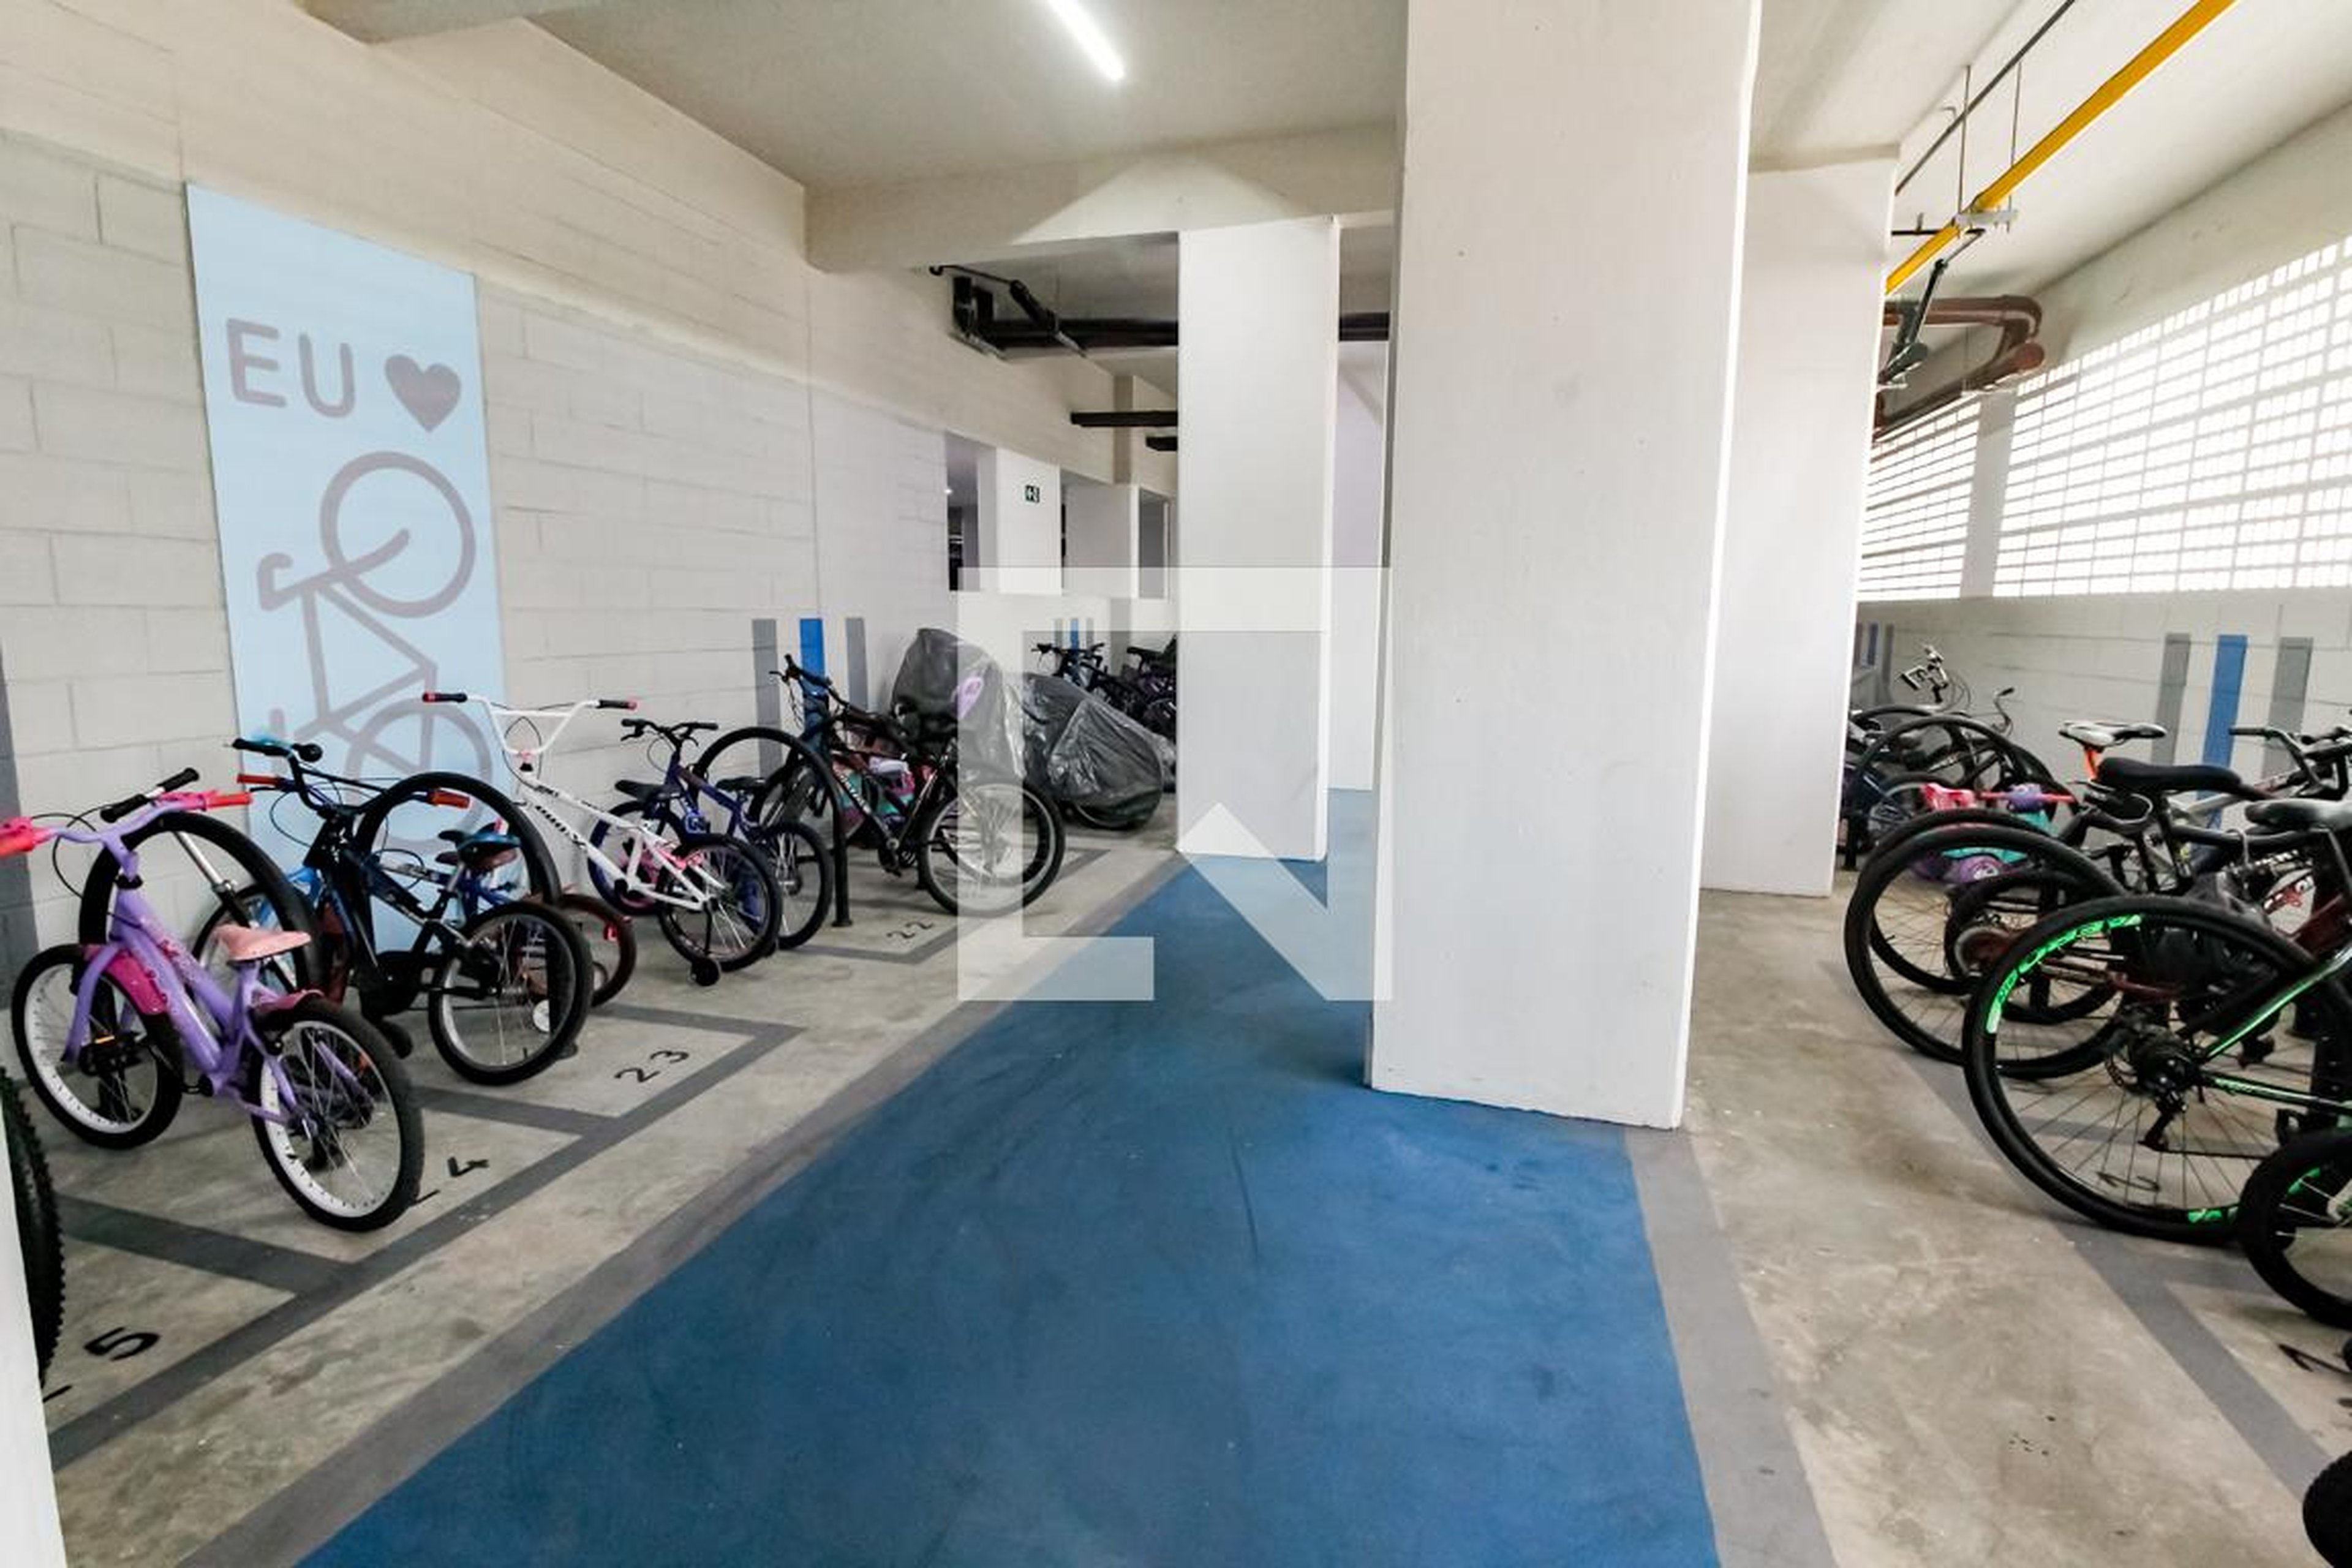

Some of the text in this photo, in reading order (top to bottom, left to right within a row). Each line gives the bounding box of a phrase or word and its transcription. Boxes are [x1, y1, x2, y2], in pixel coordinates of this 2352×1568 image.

[225, 317, 356, 418] EU
[886, 921, 935, 940] 22
[614, 1050, 690, 1084] 23
